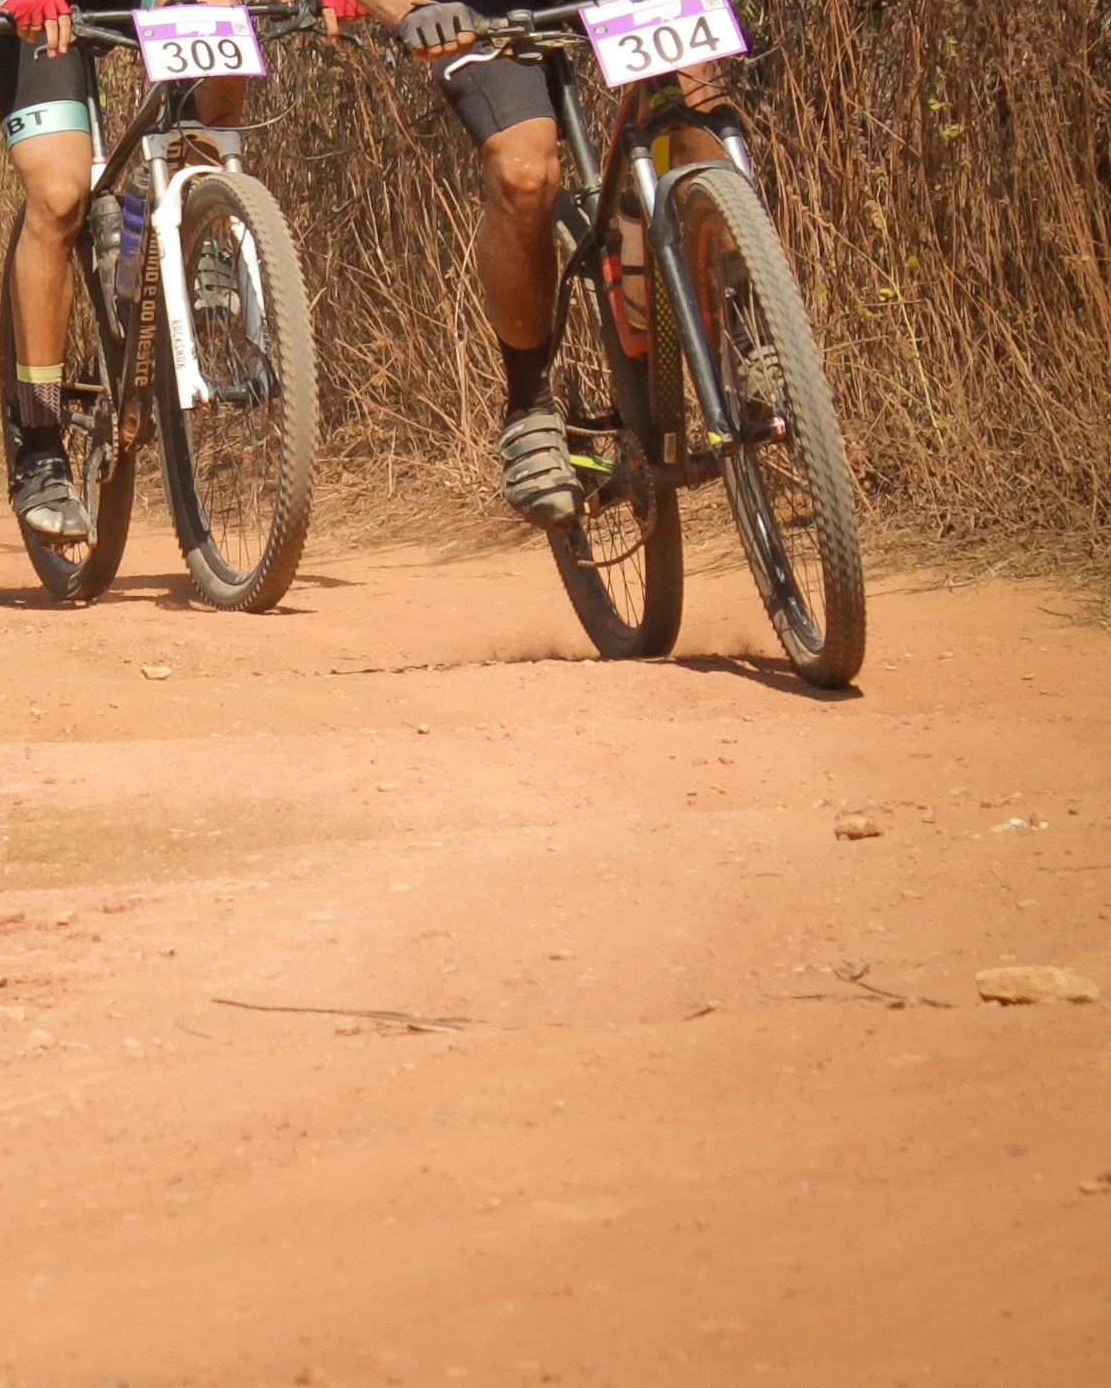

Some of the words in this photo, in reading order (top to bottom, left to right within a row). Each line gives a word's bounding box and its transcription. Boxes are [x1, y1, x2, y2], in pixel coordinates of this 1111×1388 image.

[162, 39, 243, 73] 309
[618, 16, 720, 72] 304
[140, 300, 157, 322] do
[134, 323, 157, 387] Mestre
[170, 319, 187, 370] ROCKSHOX
